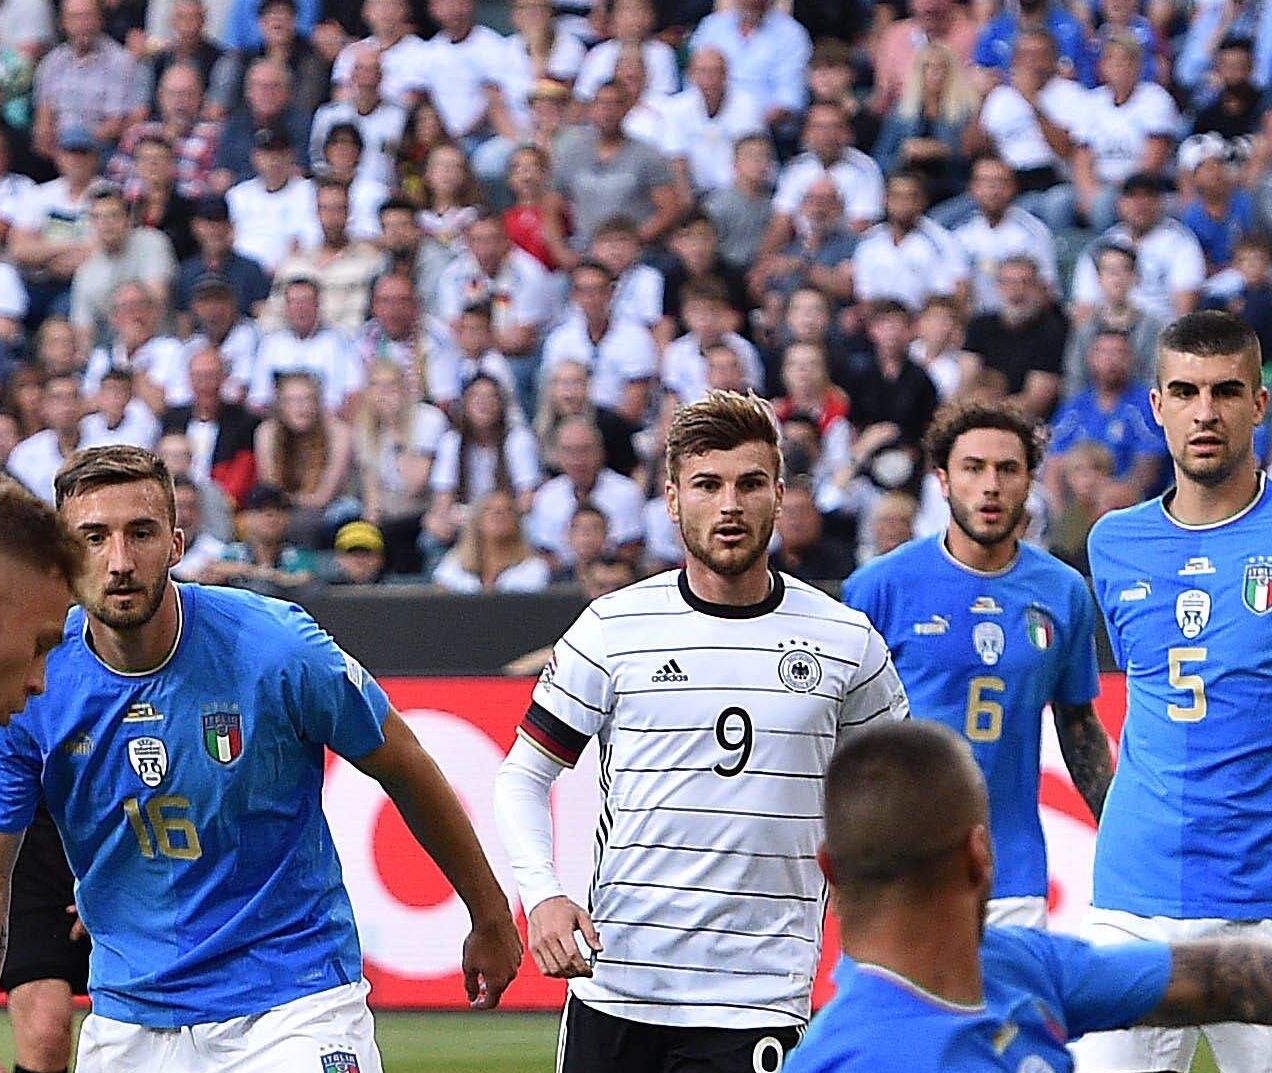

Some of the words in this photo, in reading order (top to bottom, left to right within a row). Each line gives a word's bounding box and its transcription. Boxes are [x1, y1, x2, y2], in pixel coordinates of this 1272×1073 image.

[651, 673, 689, 683] adidas
[966, 675, 1006, 742] 6
[1166, 647, 1208, 723] 5
[712, 706, 755, 779] 9
[123, 795, 203, 861] 16
[322, 1053, 357, 1067] ITALIA
